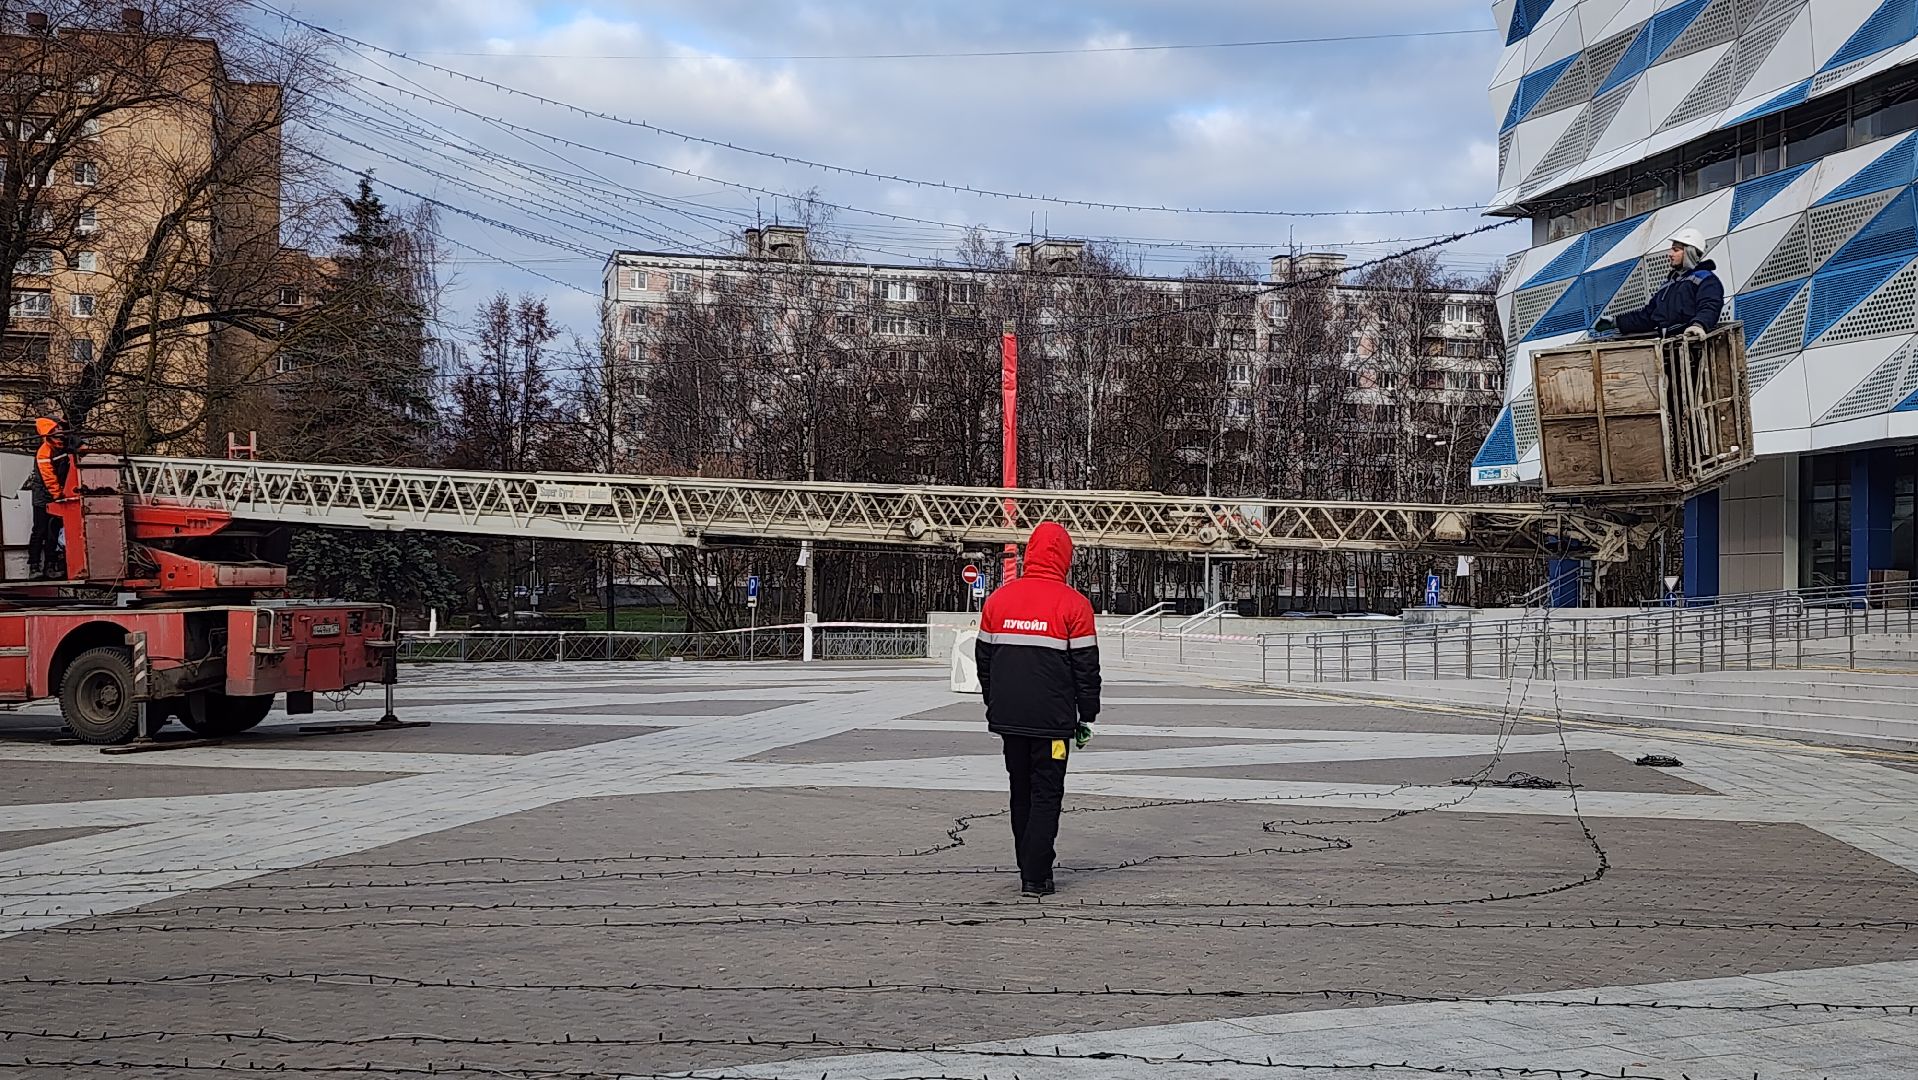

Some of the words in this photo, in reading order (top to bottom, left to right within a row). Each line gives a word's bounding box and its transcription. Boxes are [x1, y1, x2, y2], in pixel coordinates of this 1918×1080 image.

[1503, 468, 1509, 479] 3
[750, 579, 755, 595] P
[1003, 619, 1048, 631] ЛУКОЙЛ
